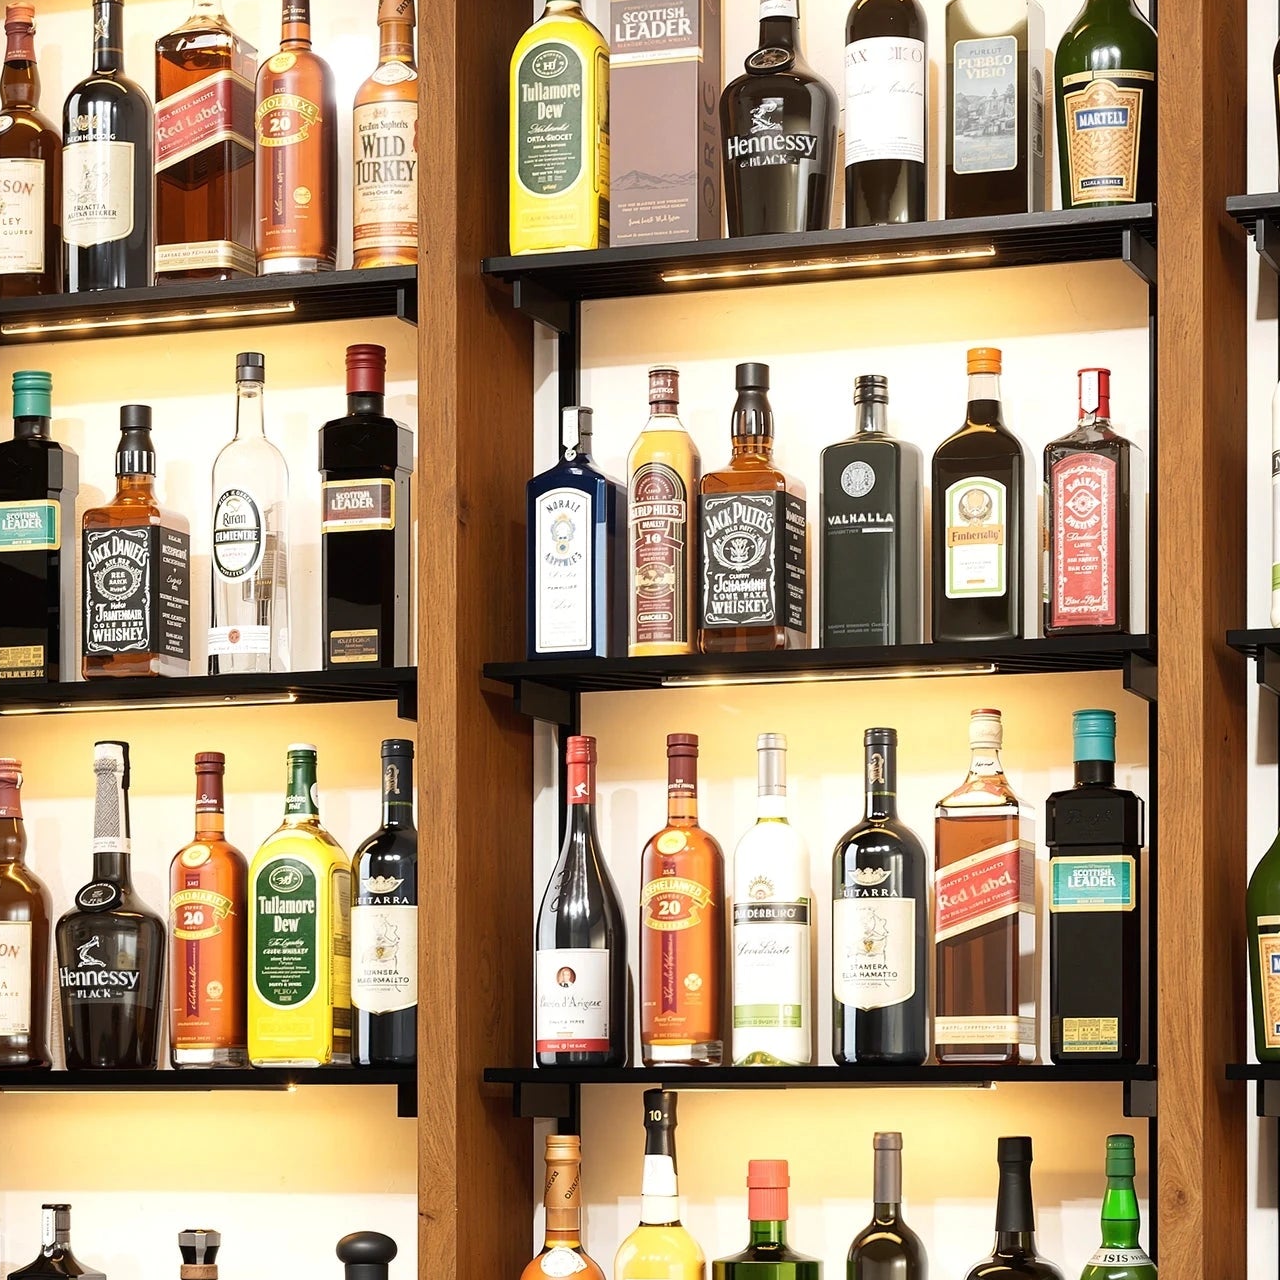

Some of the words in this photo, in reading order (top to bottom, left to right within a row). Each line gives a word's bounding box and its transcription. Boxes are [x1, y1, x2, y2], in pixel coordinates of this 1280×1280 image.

[622, 7, 685, 24] SCOTTISH
[615, 19, 692, 43] LEADER
[521, 82, 580, 103] Tullamore
[537, 102, 563, 120] Dew
[1079, 111, 1125, 128] MARTELL
[157, 118, 184, 143] Red
[270, 118, 291, 132] 20
[361, 133, 405, 160] WILD
[727, 133, 817, 161] Hennessy
[356, 160, 416, 186] TURKEY
[331, 497, 374, 510] LEADER
[1, 518, 43, 530] LEADER
[706, 508, 731, 538] JACK
[711, 600, 768, 614] WHISKEY
[1068, 875, 1116, 888] LEADER
[937, 889, 969, 911] Red
[971, 871, 1013, 898] Label
[259, 896, 315, 915] Tullamore
[658, 901, 680, 915] 20
[183, 911, 204, 925] 20
[273, 916, 299, 933] Dew
[60, 967, 139, 989] Hennessy
